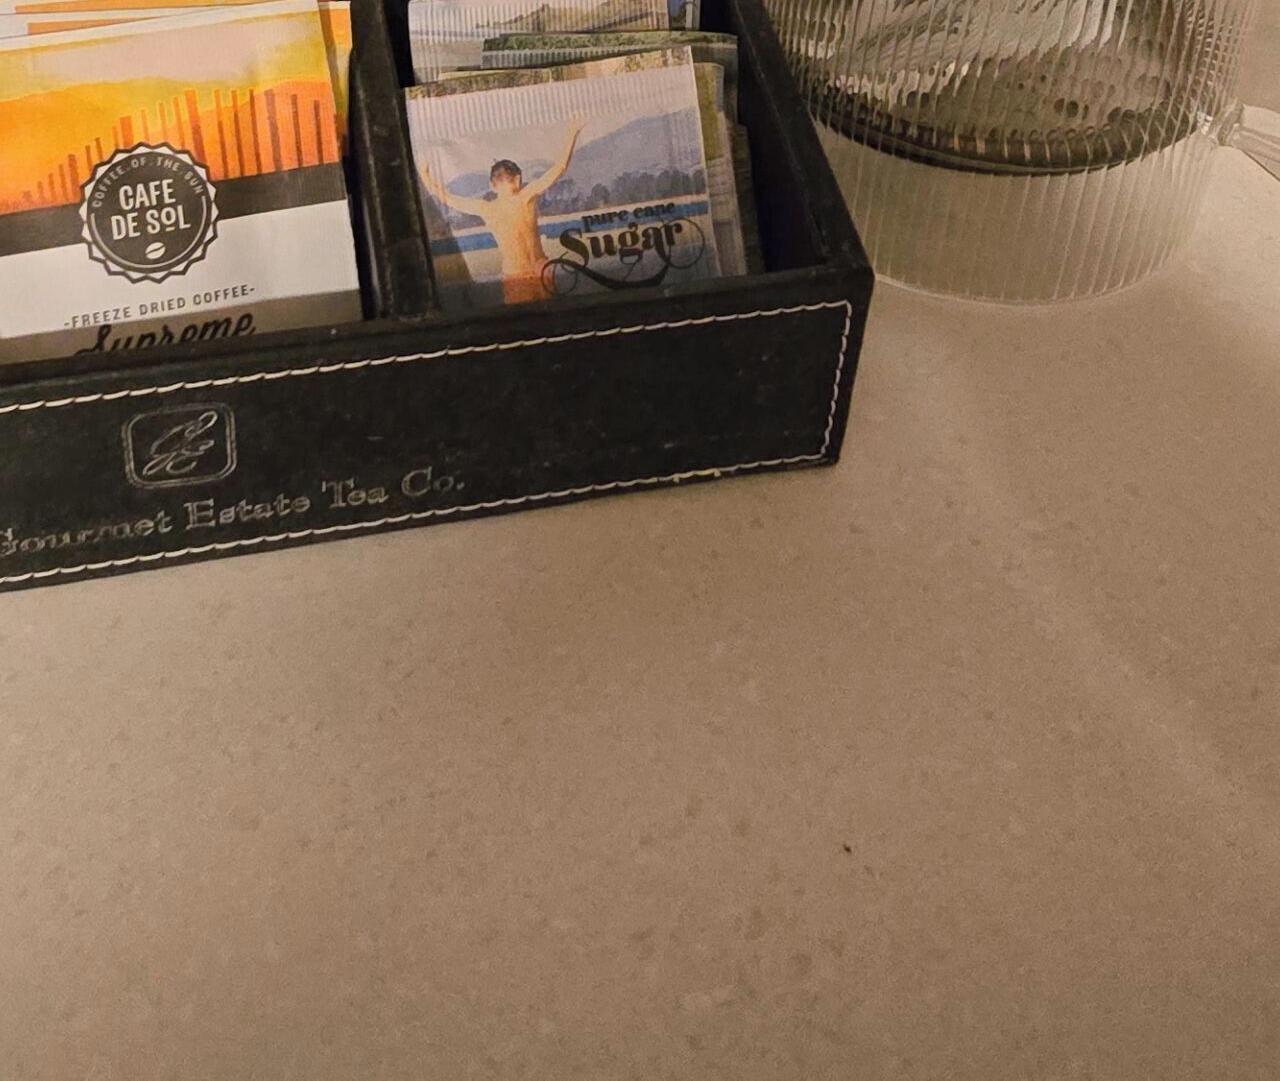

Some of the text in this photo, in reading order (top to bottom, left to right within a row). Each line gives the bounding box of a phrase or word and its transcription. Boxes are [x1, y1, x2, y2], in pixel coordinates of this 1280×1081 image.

[131, 157, 146, 168] OF
[156, 157, 180, 171] THE
[119, 179, 176, 210] CAFE
[110, 205, 191, 240] DE SOL
[581, 209, 629, 233] pure
[547, 219, 703, 282] Sugar
[139, 297, 186, 316] DRIED
[183, 493, 311, 530] Estate
[321, 476, 390, 509] Tea
[401, 466, 466, 498] Co.
